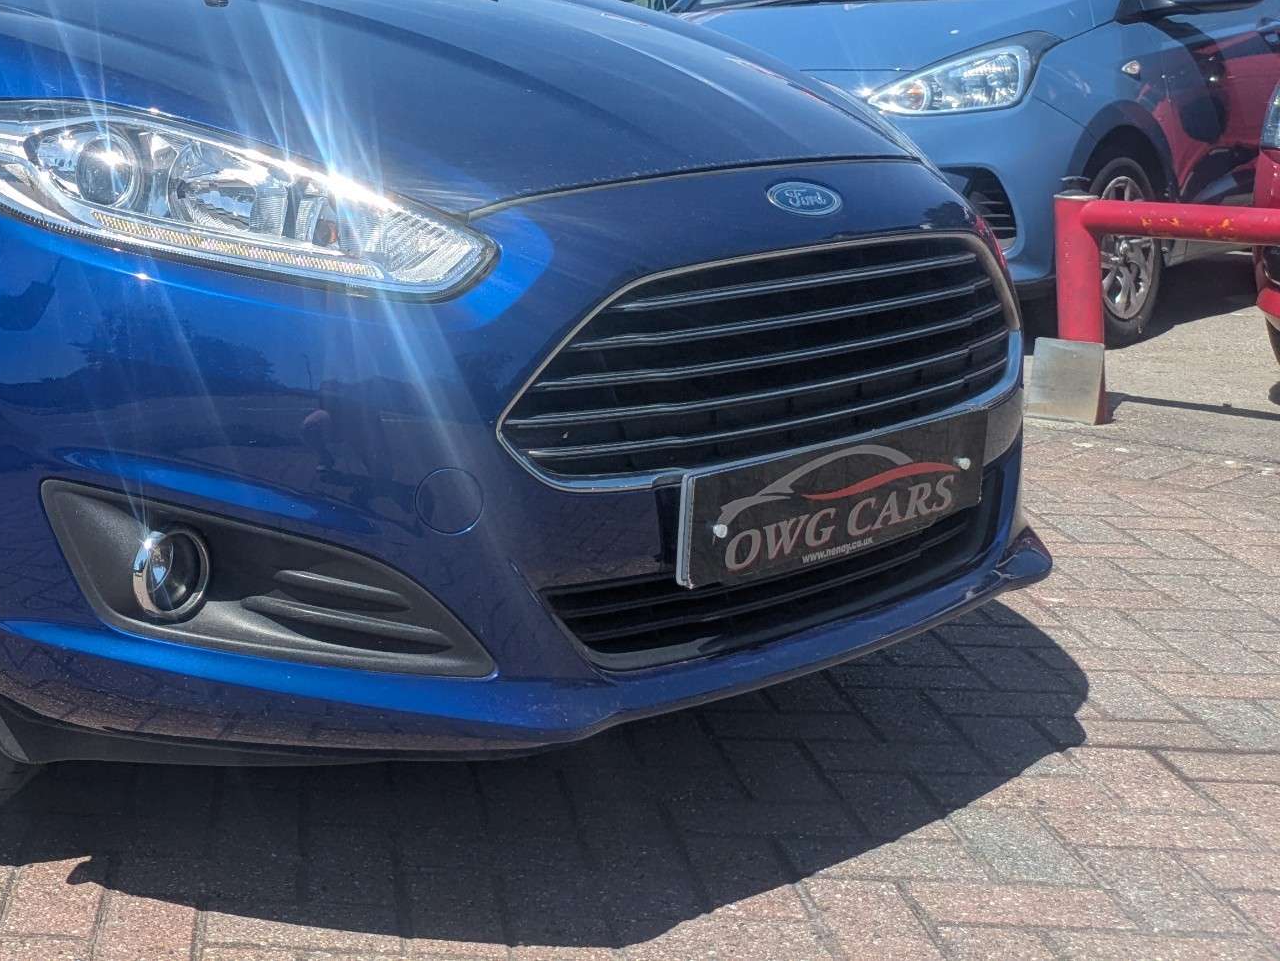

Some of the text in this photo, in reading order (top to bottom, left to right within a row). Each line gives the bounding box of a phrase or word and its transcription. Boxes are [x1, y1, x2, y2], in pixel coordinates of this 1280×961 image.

[784, 189, 826, 207] Ford
[724, 474, 954, 572] OWG CARS
